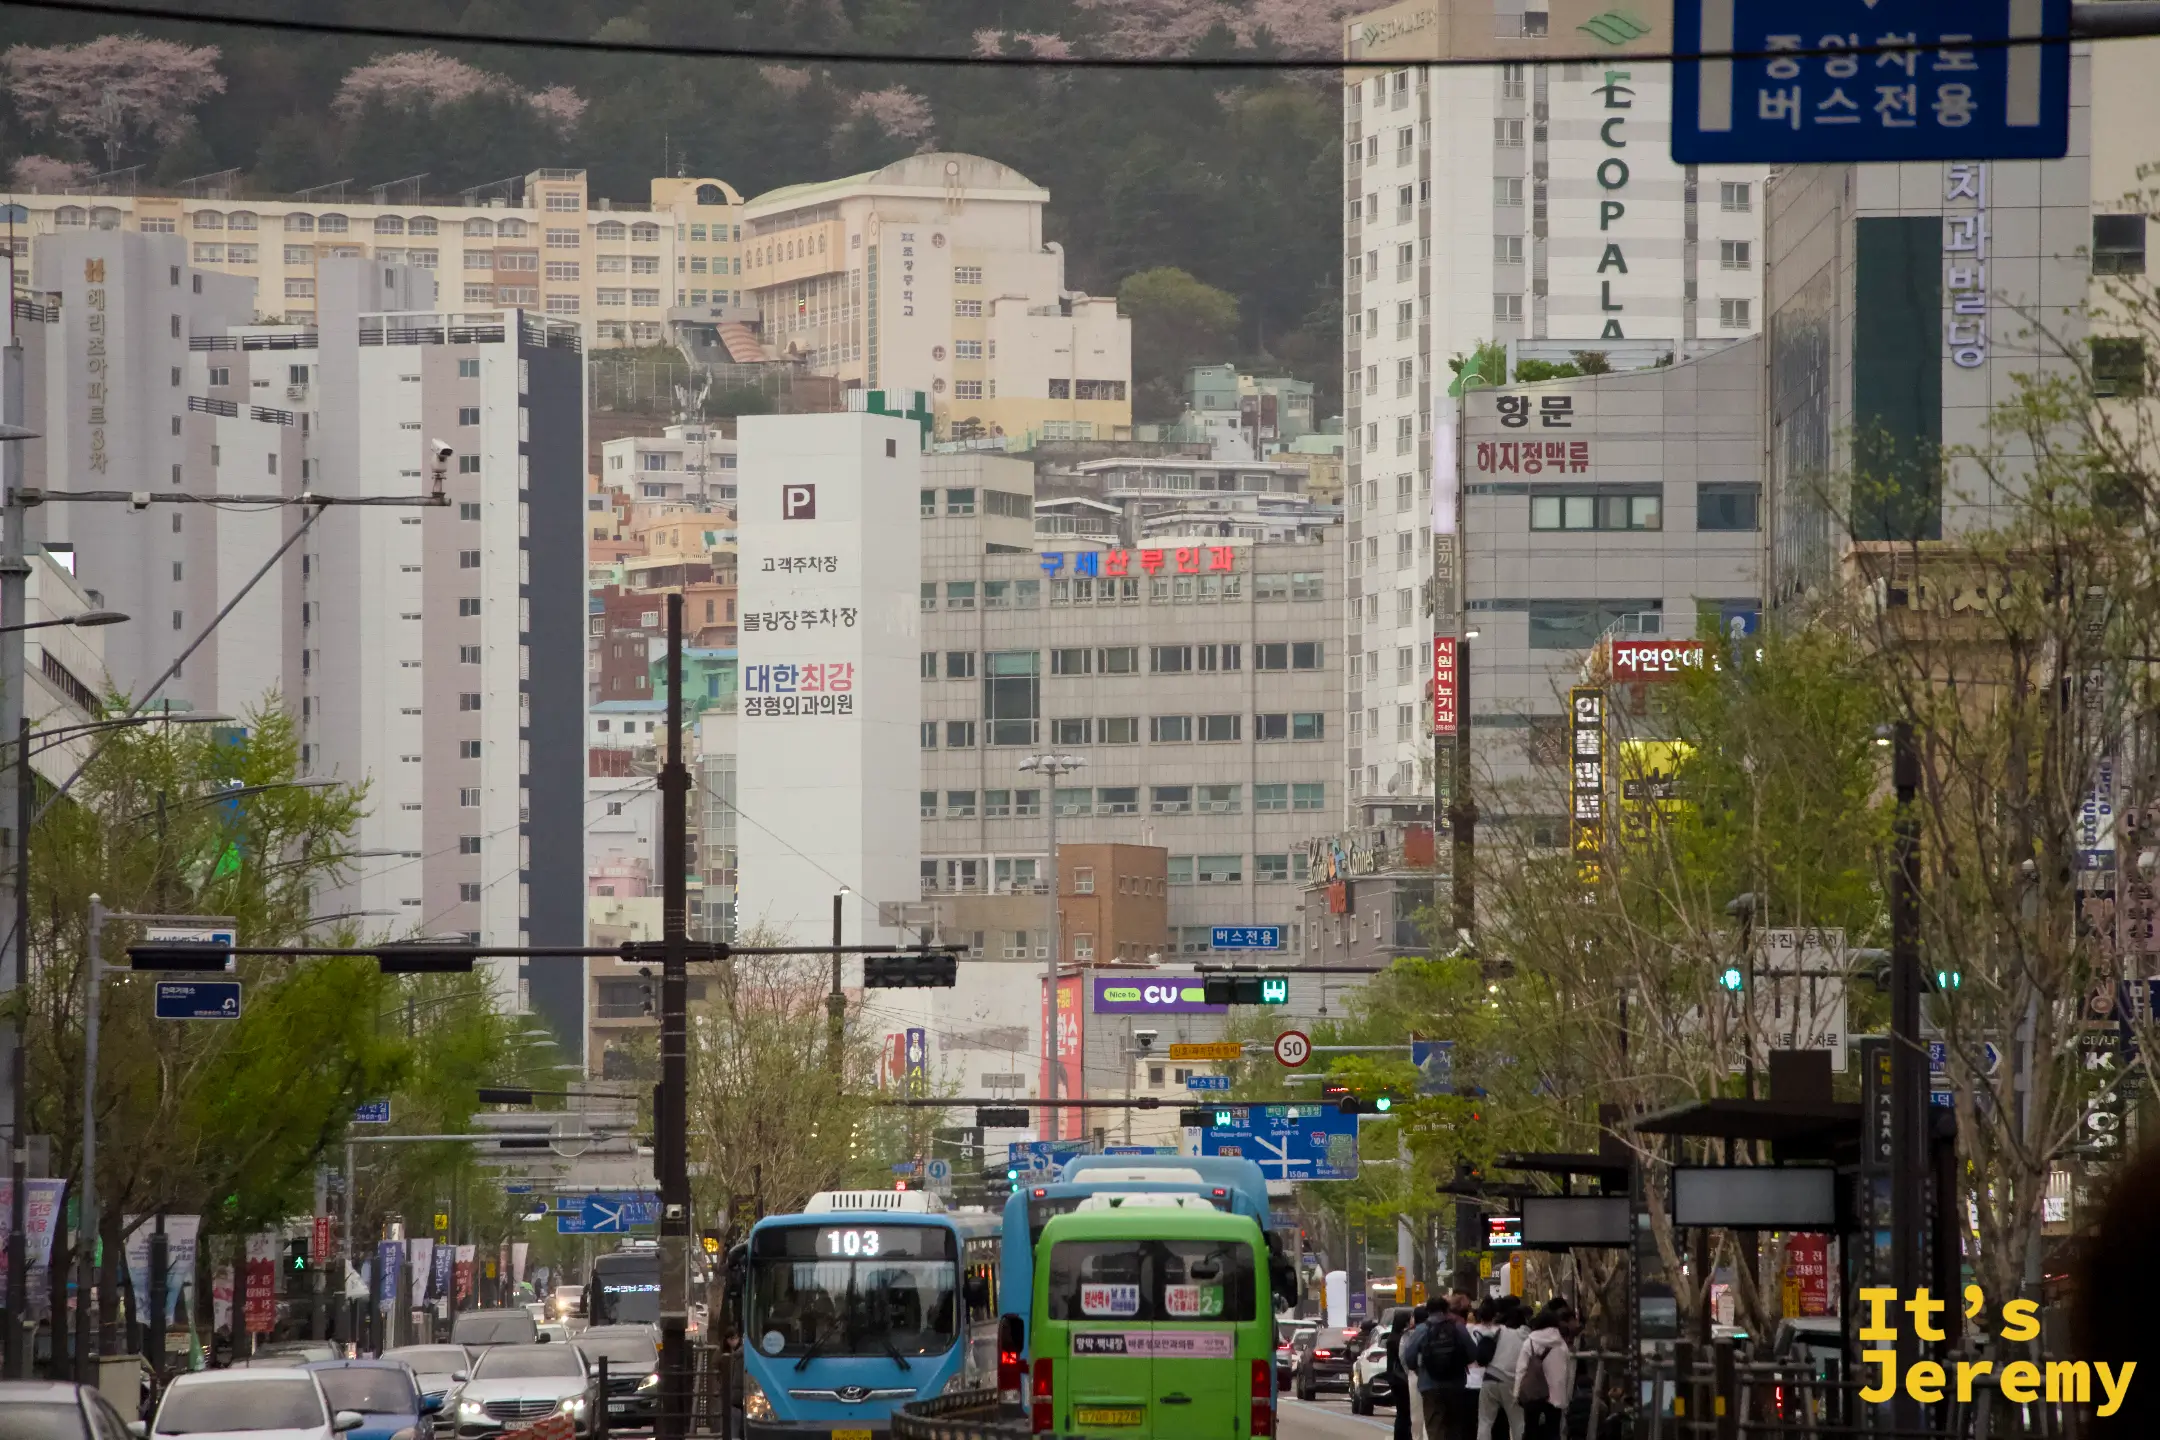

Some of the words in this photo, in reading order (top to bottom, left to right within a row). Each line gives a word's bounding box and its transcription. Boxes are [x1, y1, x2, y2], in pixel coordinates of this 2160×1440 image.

[1765, 32, 1979, 79] 중앙차로
[1758, 83, 1978, 130] 버스전용
[1944, 163, 1988, 368] 치과빌딩
[1496, 396, 1574, 428] 항문
[1477, 441, 1588, 474] 하지정맥류
[787, 487, 811, 517] P
[761, 556, 838, 574] 고객주차장
[743, 607, 859, 632] 볼링장주차장
[745, 662, 855, 693] 대한최강
[1437, 641, 1455, 723] 시원비뇨기과
[744, 694, 854, 717] 정형외과의원
[1216, 930, 1273, 946] 버스전용
[1110, 990, 1128, 999] Nice
[1130, 990, 1136, 999] to
[1144, 985, 1177, 1004] CU
[1283, 1041, 1302, 1057] 50
[1190, 1079, 1225, 1088] 버스전용
[827, 1230, 880, 1256] 103
